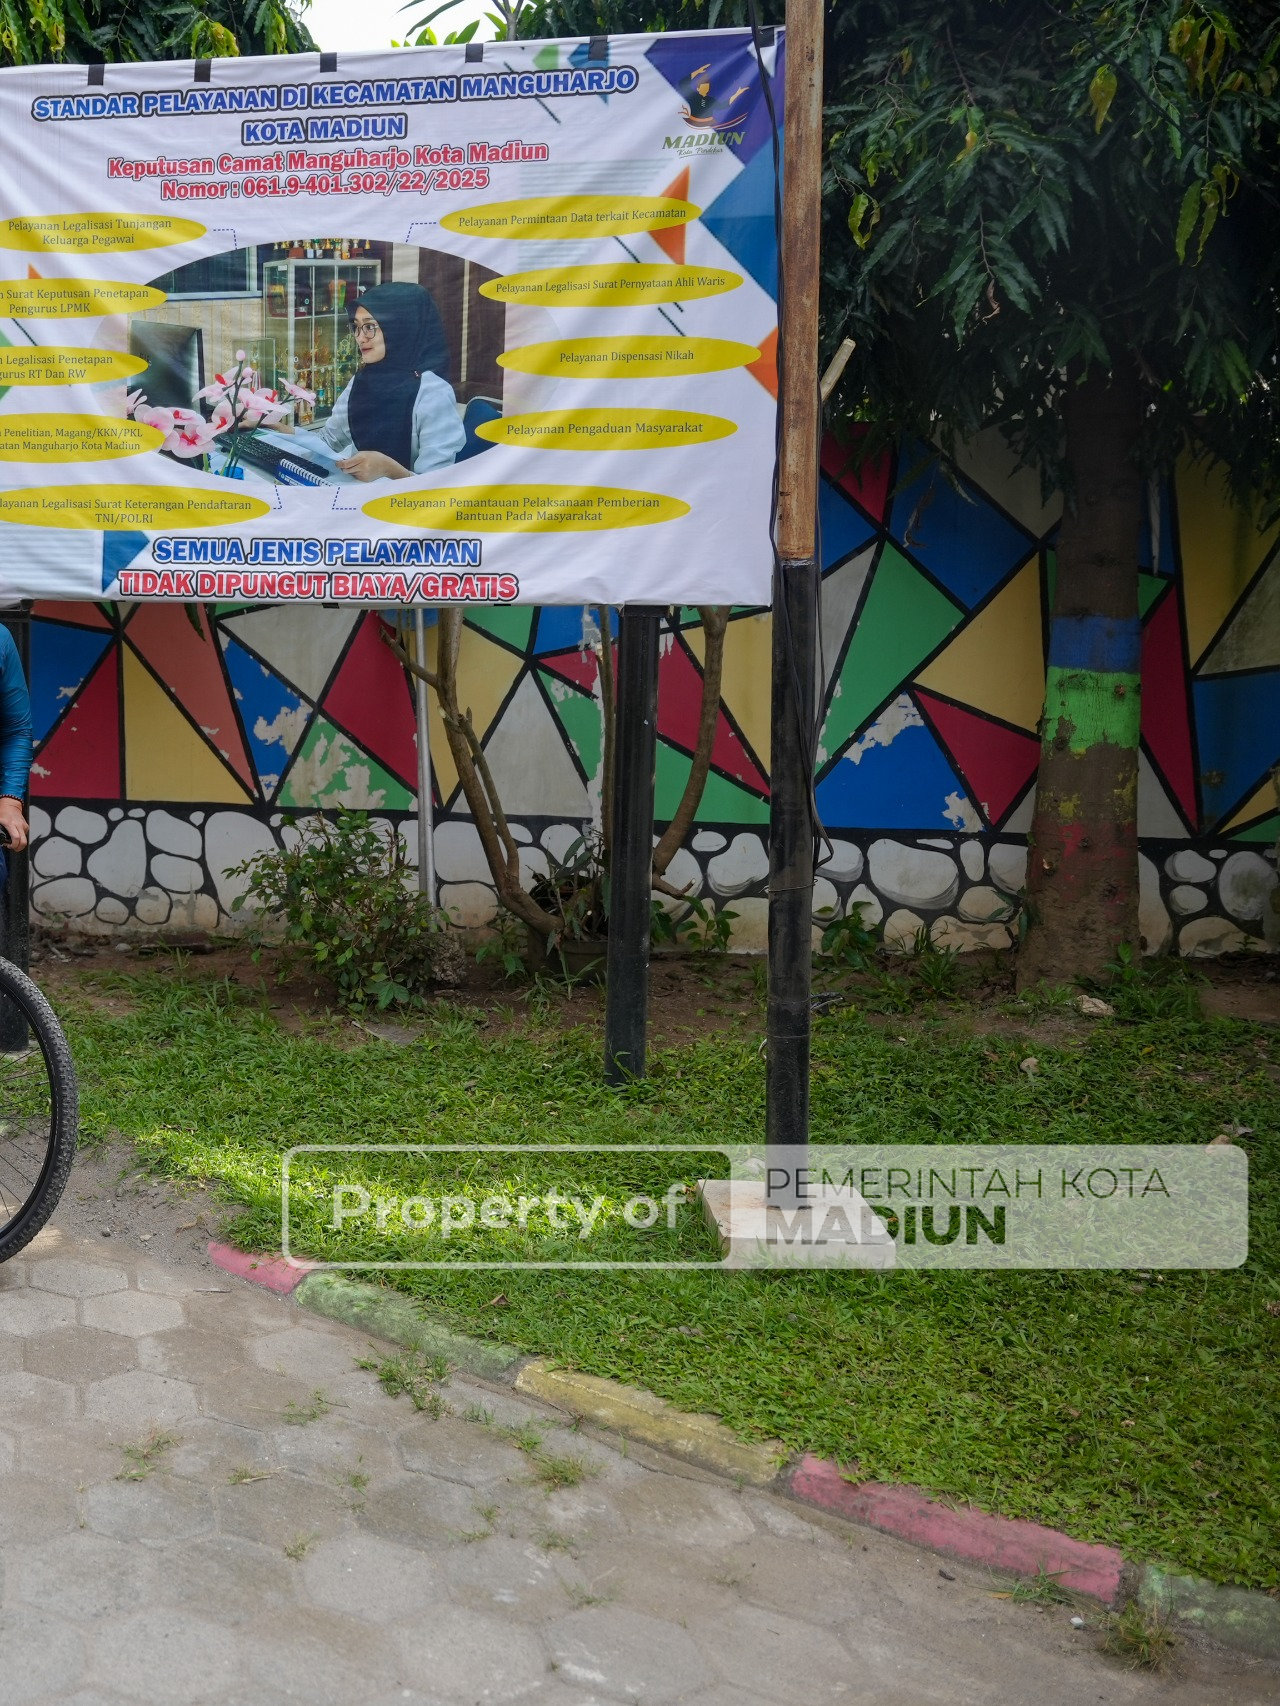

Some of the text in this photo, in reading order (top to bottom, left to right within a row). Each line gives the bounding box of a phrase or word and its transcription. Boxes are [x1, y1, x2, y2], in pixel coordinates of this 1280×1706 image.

[34, 69, 634, 118] STANDAR PELAYANAN DI KECAMATAN MANGUHARJO
[245, 117, 404, 141] KOTA MADIUN
[662, 132, 746, 149] MADIUN
[109, 142, 548, 180] Keputusan Camat Manguharjo Kota Madiun
[162, 180, 228, 199] Nomor
[243, 169, 489, 197] 061.9-401.302/22/2025
[458, 208, 686, 228] Pelayanan Permintaan Data terkait Kecamatan
[9, 219, 172, 232] Pelayanan Legalisasi Tunjangan
[43, 234, 135, 246] Keluarga Pegawai
[496, 277, 725, 295] Pelayanan Legalisasi Surat Pernyataan Ahli Waris
[6, 290, 34, 299] Surat
[37, 289, 90, 301] Keputusan
[93, 289, 149, 301] Penetapan
[9, 303, 90, 316] Pengurus LPMK
[6, 355, 55, 367] Legalisasi
[58, 355, 113, 367] Penetapan
[559, 350, 694, 365] Pelayanan Dispensasi Nikah
[28, 370, 42, 378] RT
[45, 370, 64, 378] Dan
[68, 370, 86, 378] RW
[4, 428, 53, 439] Penelitian,
[55, 428, 143, 440] Magang/KKN/PKL
[507, 422, 703, 436] Pelayanan Pengaduan Masyarakat
[22, 441, 78, 453] Manguharjo
[81, 441, 102, 450] Kota
[104, 441, 140, 450] Madiun
[41, 499, 92, 511] Legalisasi
[94, 499, 122, 509] Surat
[125, 499, 184, 511] Keterangan
[187, 500, 252, 510] Pendaftaran
[390, 497, 660, 510] Pelayanan Pemantauan Pelaksanaan Pemberian
[95, 513, 153, 524] TNI/POLRI
[456, 511, 602, 523] Bantuan Pada Masyarakat
[153, 539, 480, 565] SEMUA JENIS PELAYANAN
[120, 571, 518, 602] TIDAK DIPUNGUT BIAYA/GRATIS
